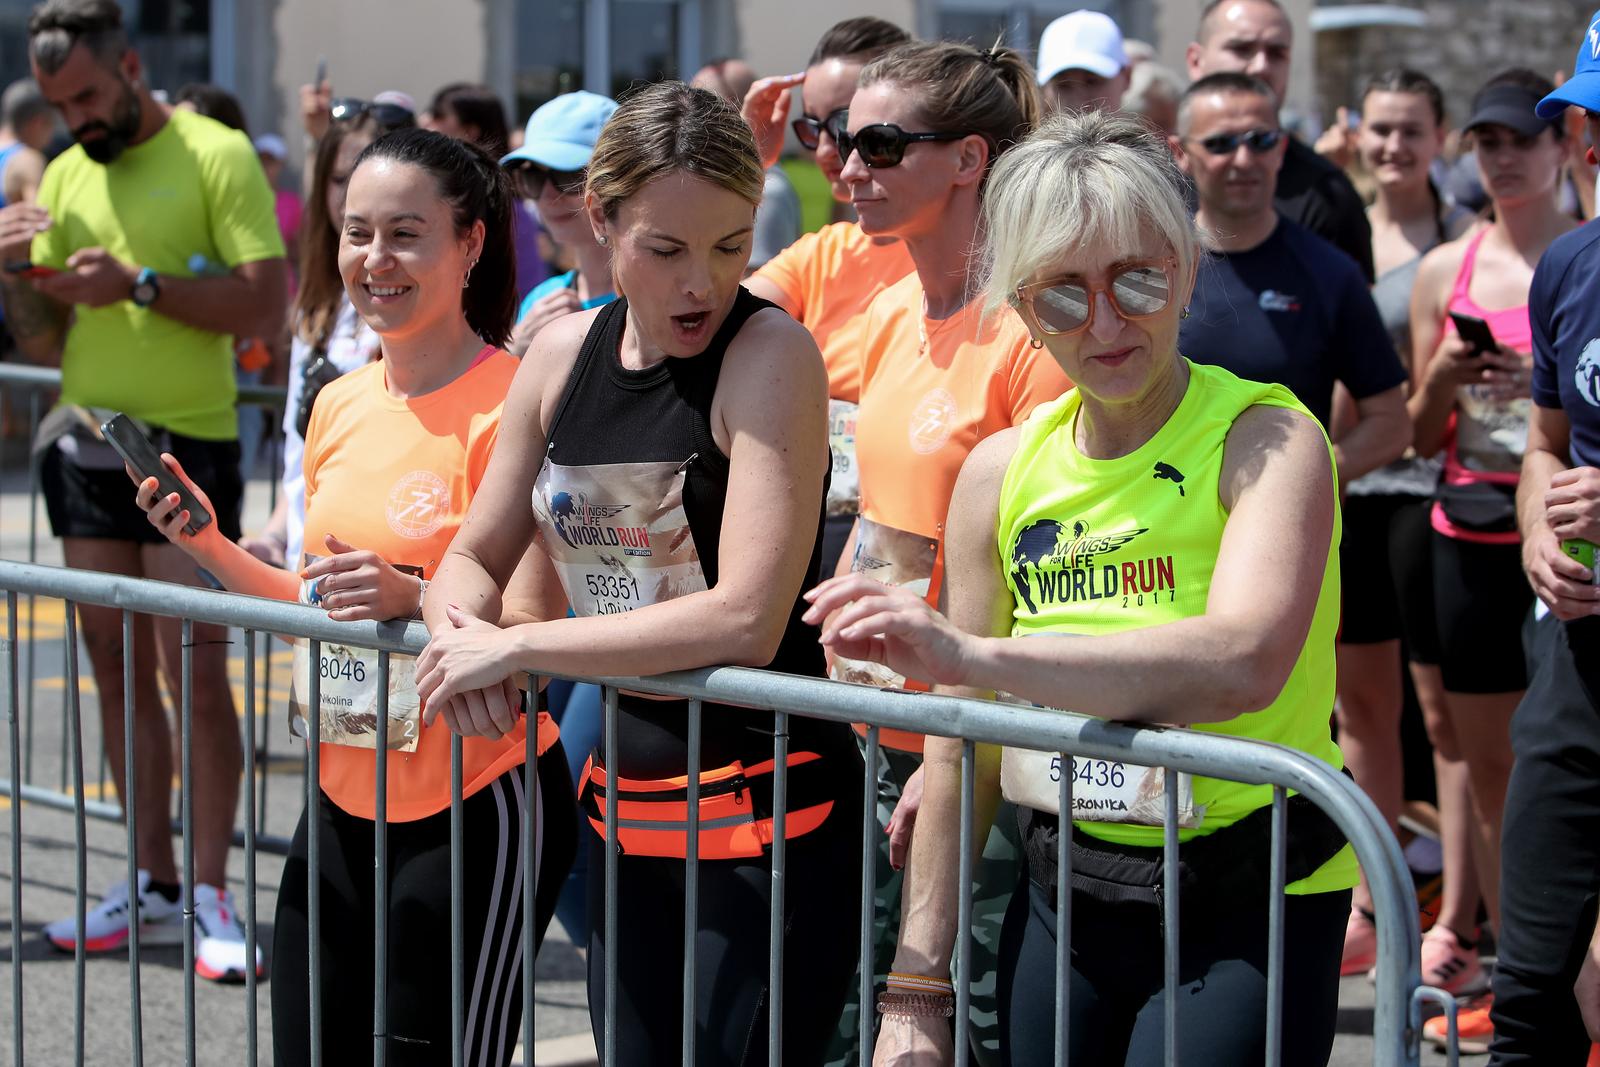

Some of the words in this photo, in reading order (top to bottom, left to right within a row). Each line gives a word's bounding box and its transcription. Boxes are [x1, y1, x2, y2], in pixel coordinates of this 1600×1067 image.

[574, 506, 608, 517] WINGS
[582, 516, 601, 526] LIFE
[567, 525, 620, 547] WORLD
[616, 527, 651, 548] RUN
[1056, 537, 1111, 556] WINGS
[1049, 556, 1062, 565] FOR
[1061, 553, 1095, 569] LIFE
[586, 574, 641, 601] 53351
[1036, 564, 1119, 605] WORLD
[1121, 555, 1176, 596] RUN
[1122, 590, 1176, 609] 2017
[403, 720, 415, 738] 2
[1070, 797, 1128, 812] ERONIKA
